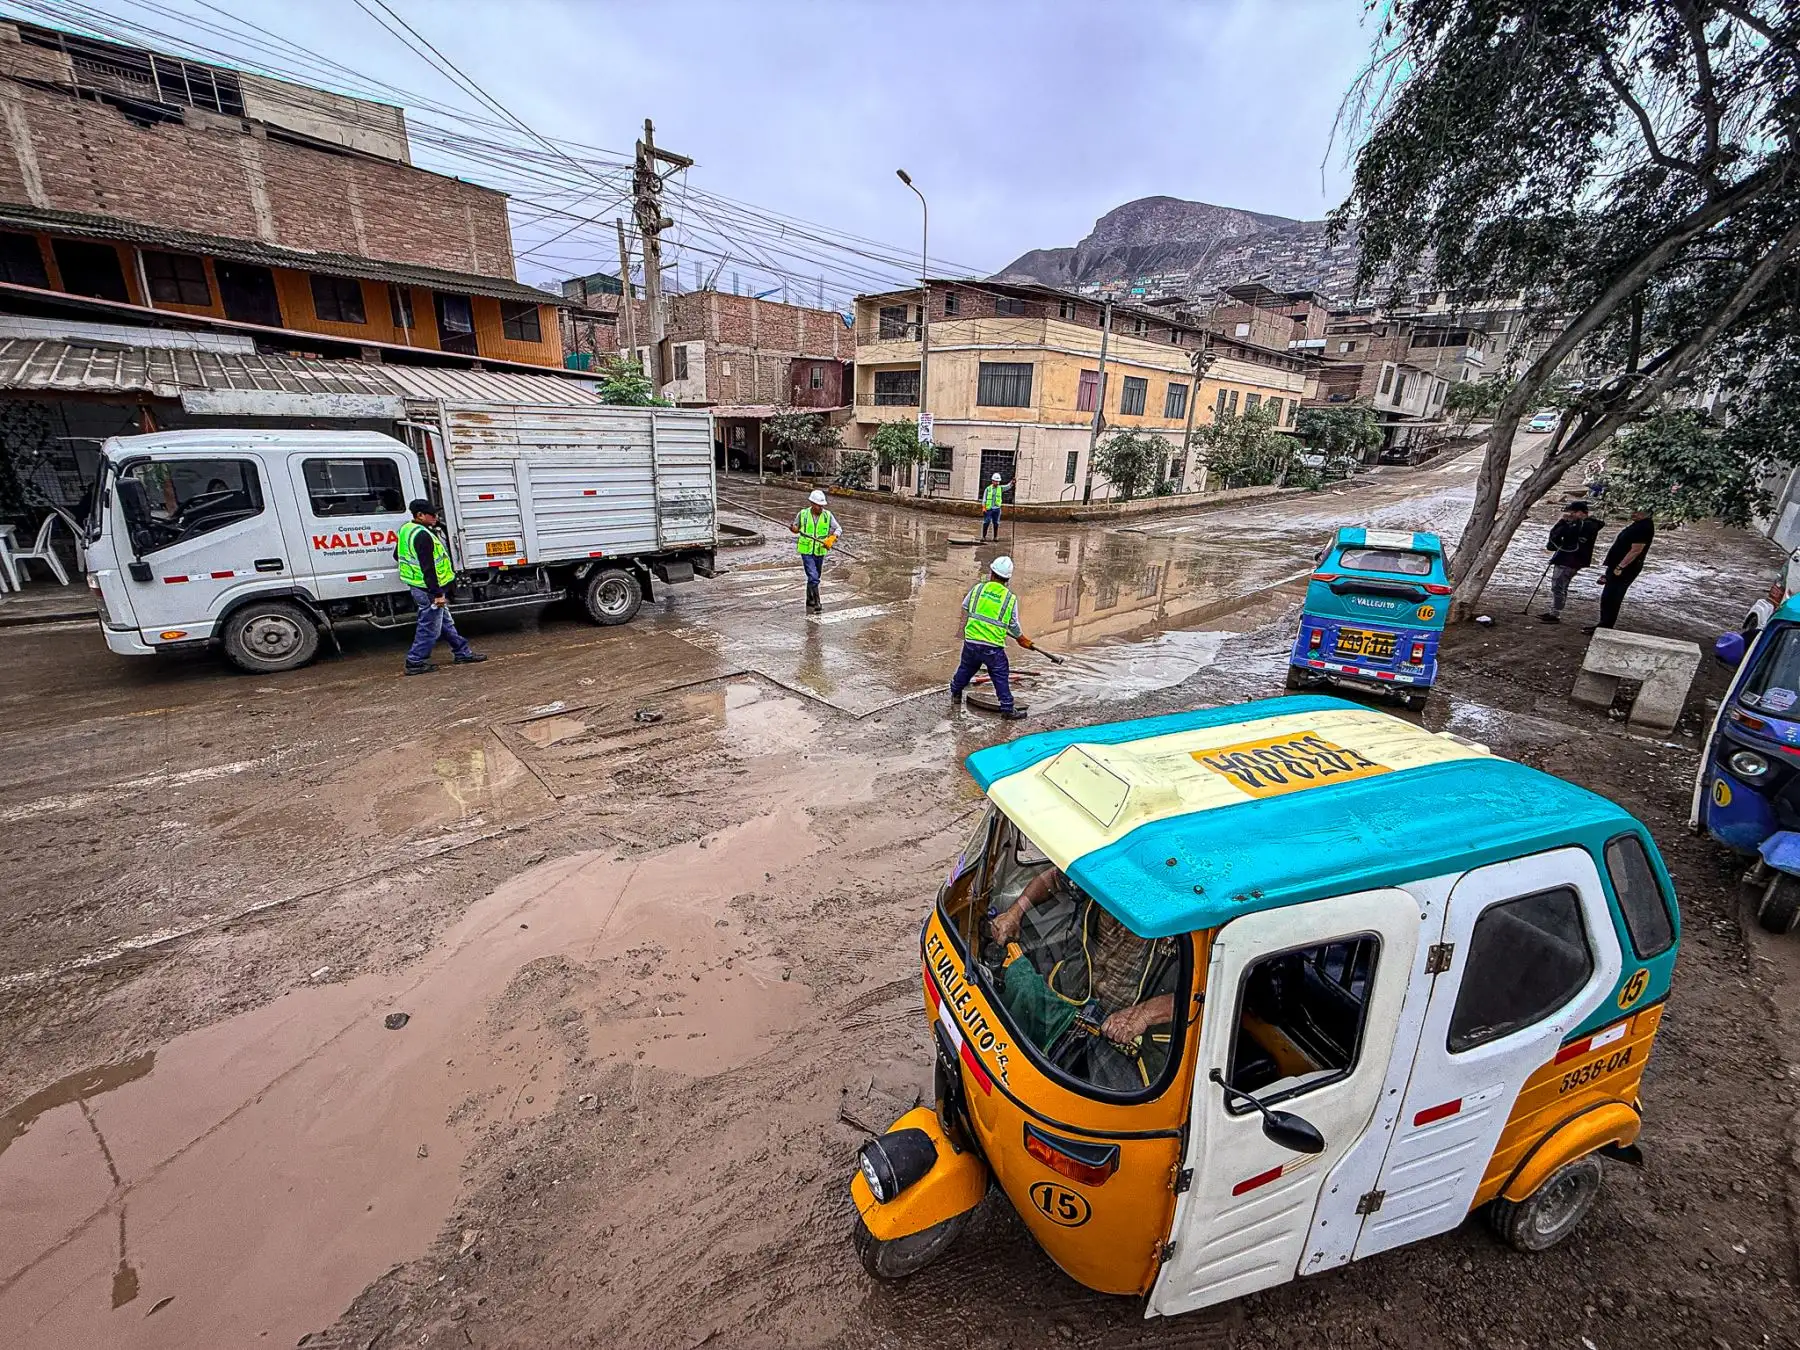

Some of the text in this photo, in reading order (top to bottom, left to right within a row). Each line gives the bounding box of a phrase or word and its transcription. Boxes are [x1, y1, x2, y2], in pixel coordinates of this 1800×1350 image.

[312, 530, 399, 550] KALLPA
[1357, 597, 1395, 609] VALLEJITO
[1417, 606, 1434, 618] 116
[1716, 781, 1725, 801] 6
[1619, 969, 1648, 1006] 15
[937, 953, 996, 1052] VALLEJITO
[1041, 1187, 1078, 1220] 15
